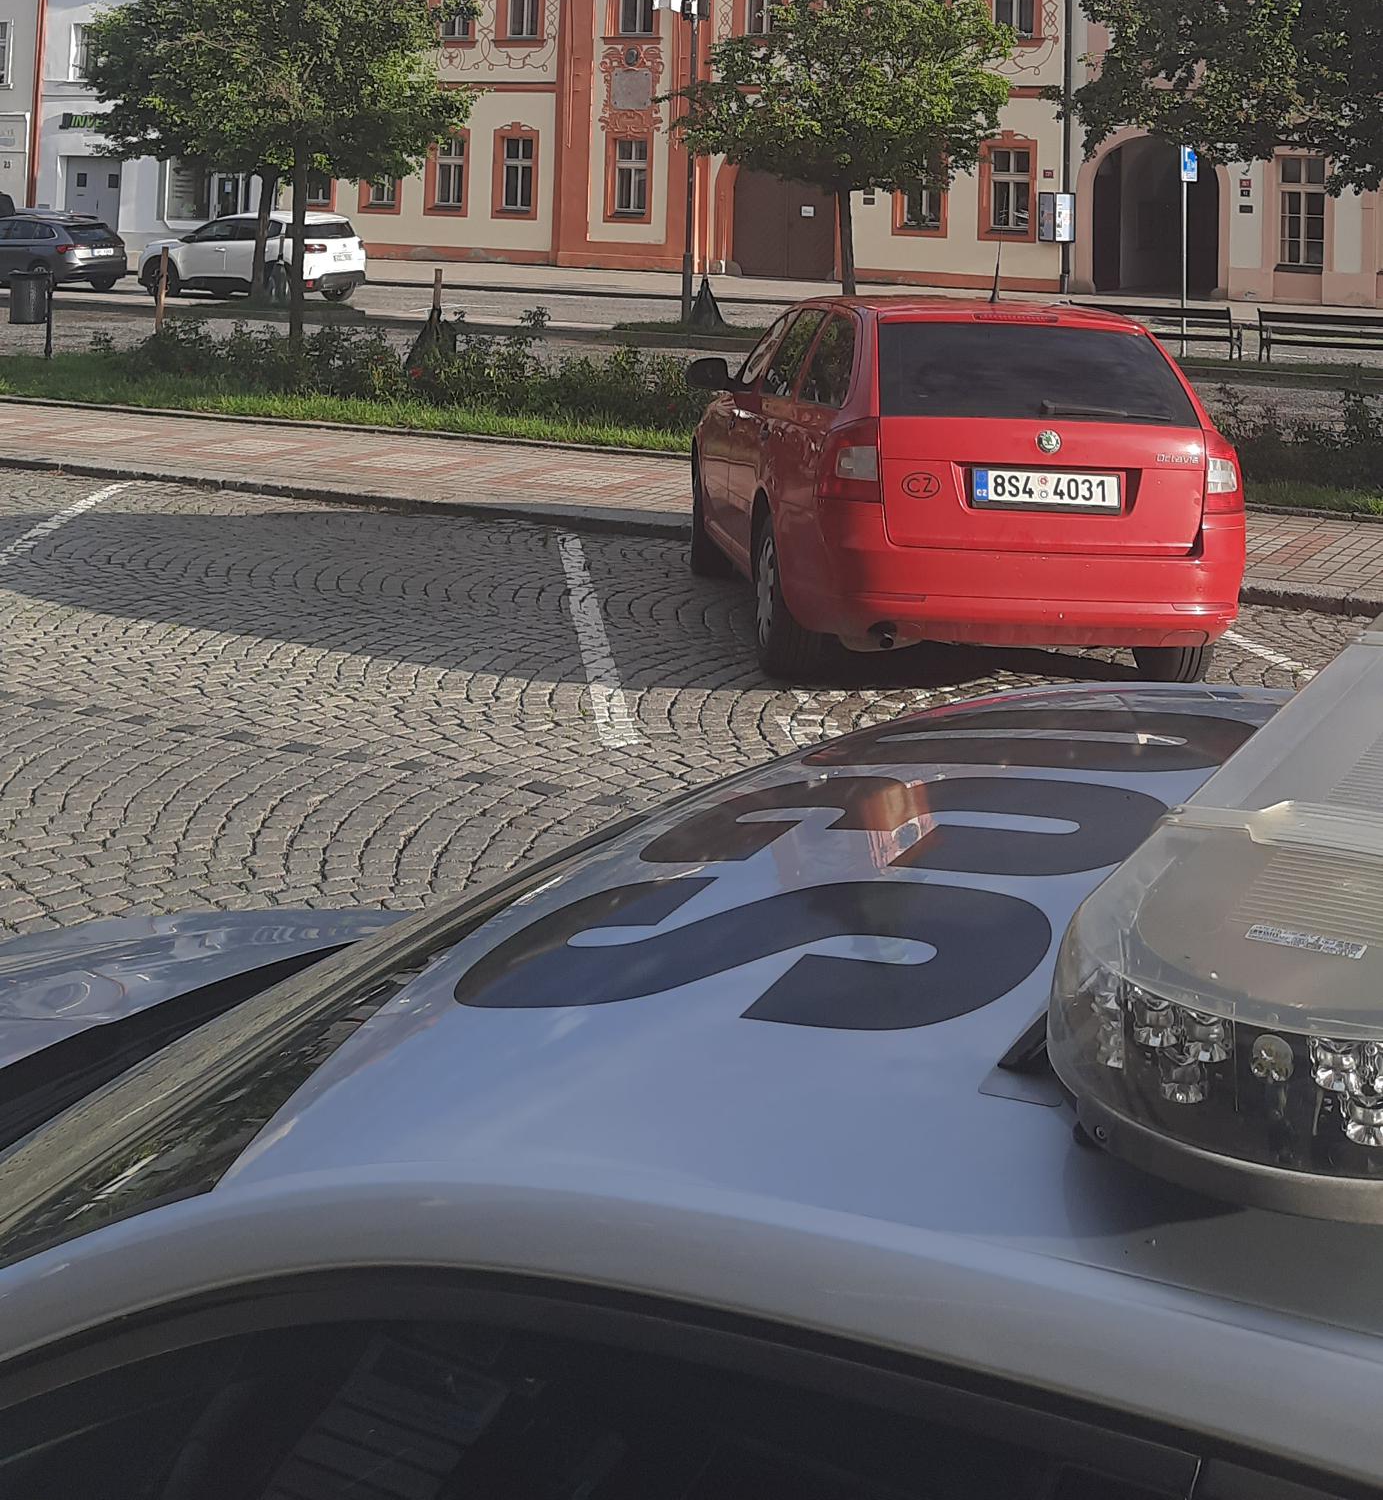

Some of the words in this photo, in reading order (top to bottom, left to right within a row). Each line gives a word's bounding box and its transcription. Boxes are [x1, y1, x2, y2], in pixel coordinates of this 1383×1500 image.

[906, 477, 933, 493] CZ
[993, 474, 1035, 498] 8S4
[1052, 477, 1107, 503] 4031
